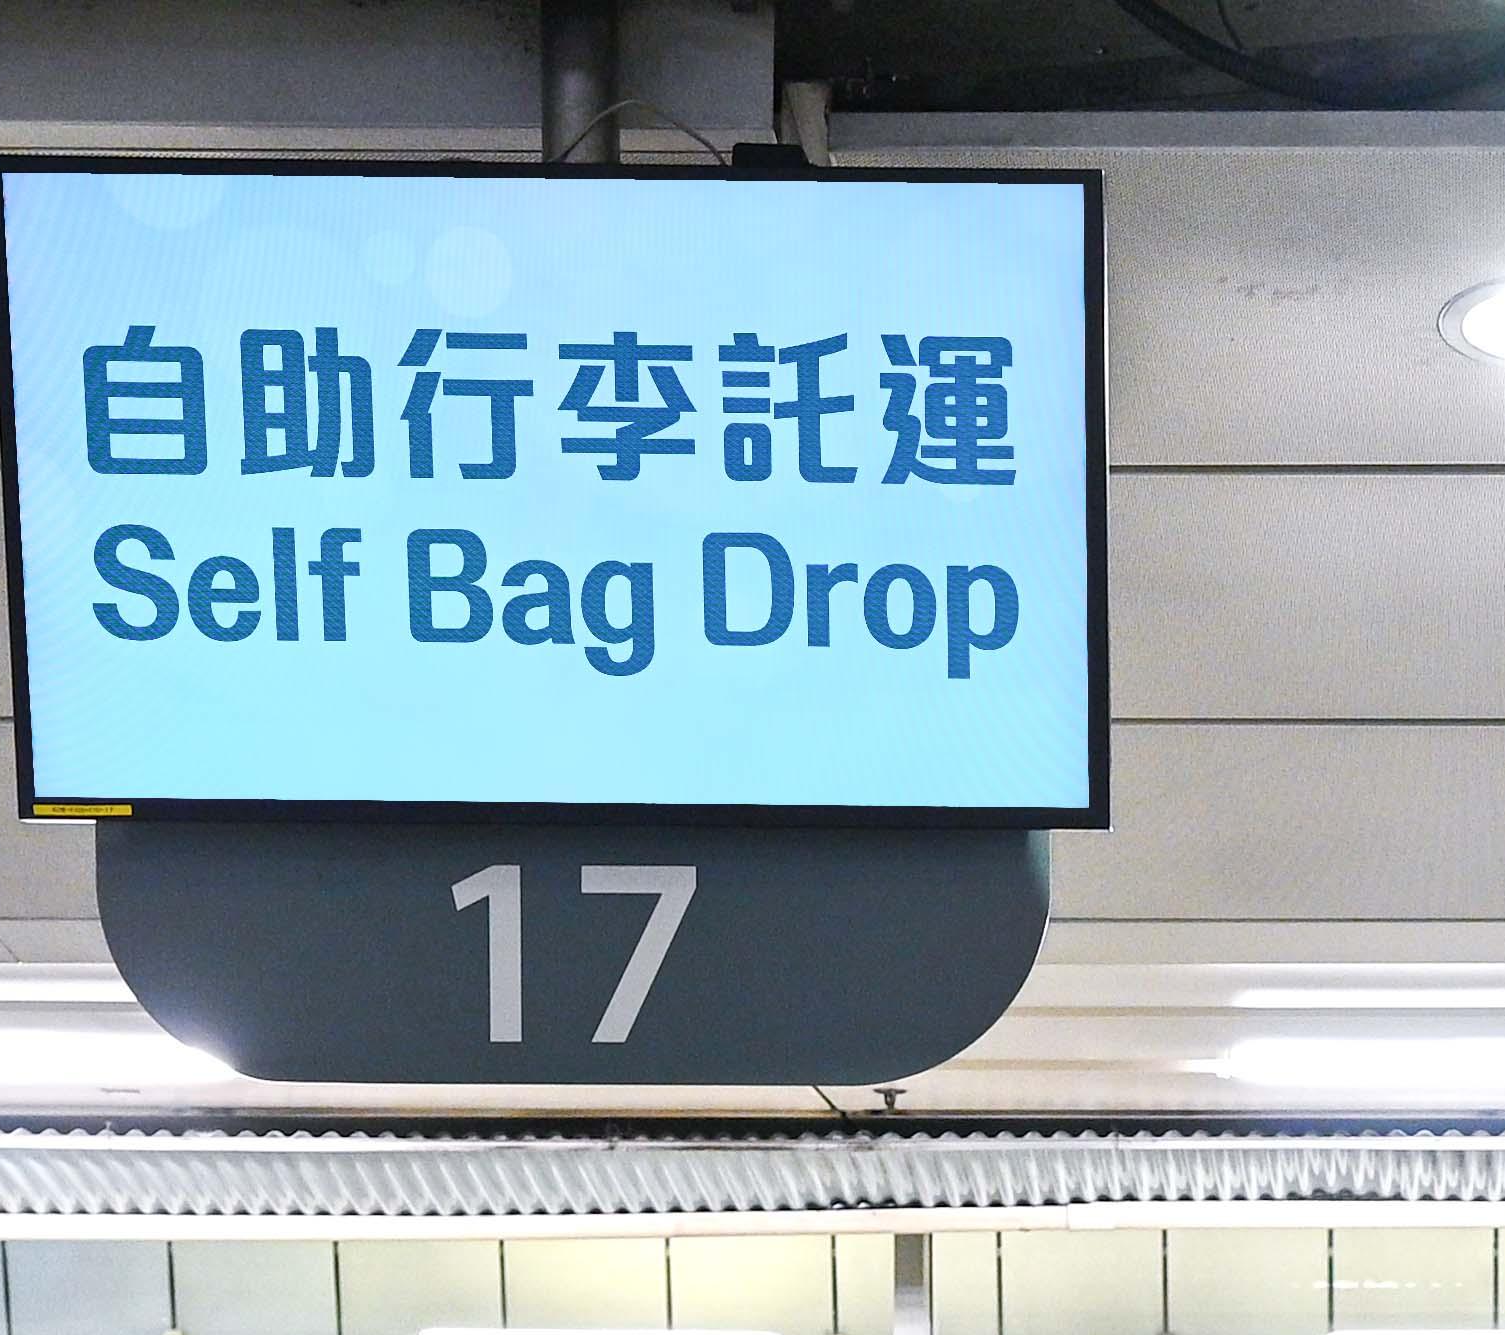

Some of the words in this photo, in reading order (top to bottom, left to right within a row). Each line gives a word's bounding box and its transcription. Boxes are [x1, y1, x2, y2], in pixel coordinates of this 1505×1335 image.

[82, 324, 1017, 486] 自助行李託運
[92, 523, 362, 643] Self
[406, 528, 655, 677] Bag
[702, 532, 1020, 680] Drop
[451, 864, 697, 1043] 17
